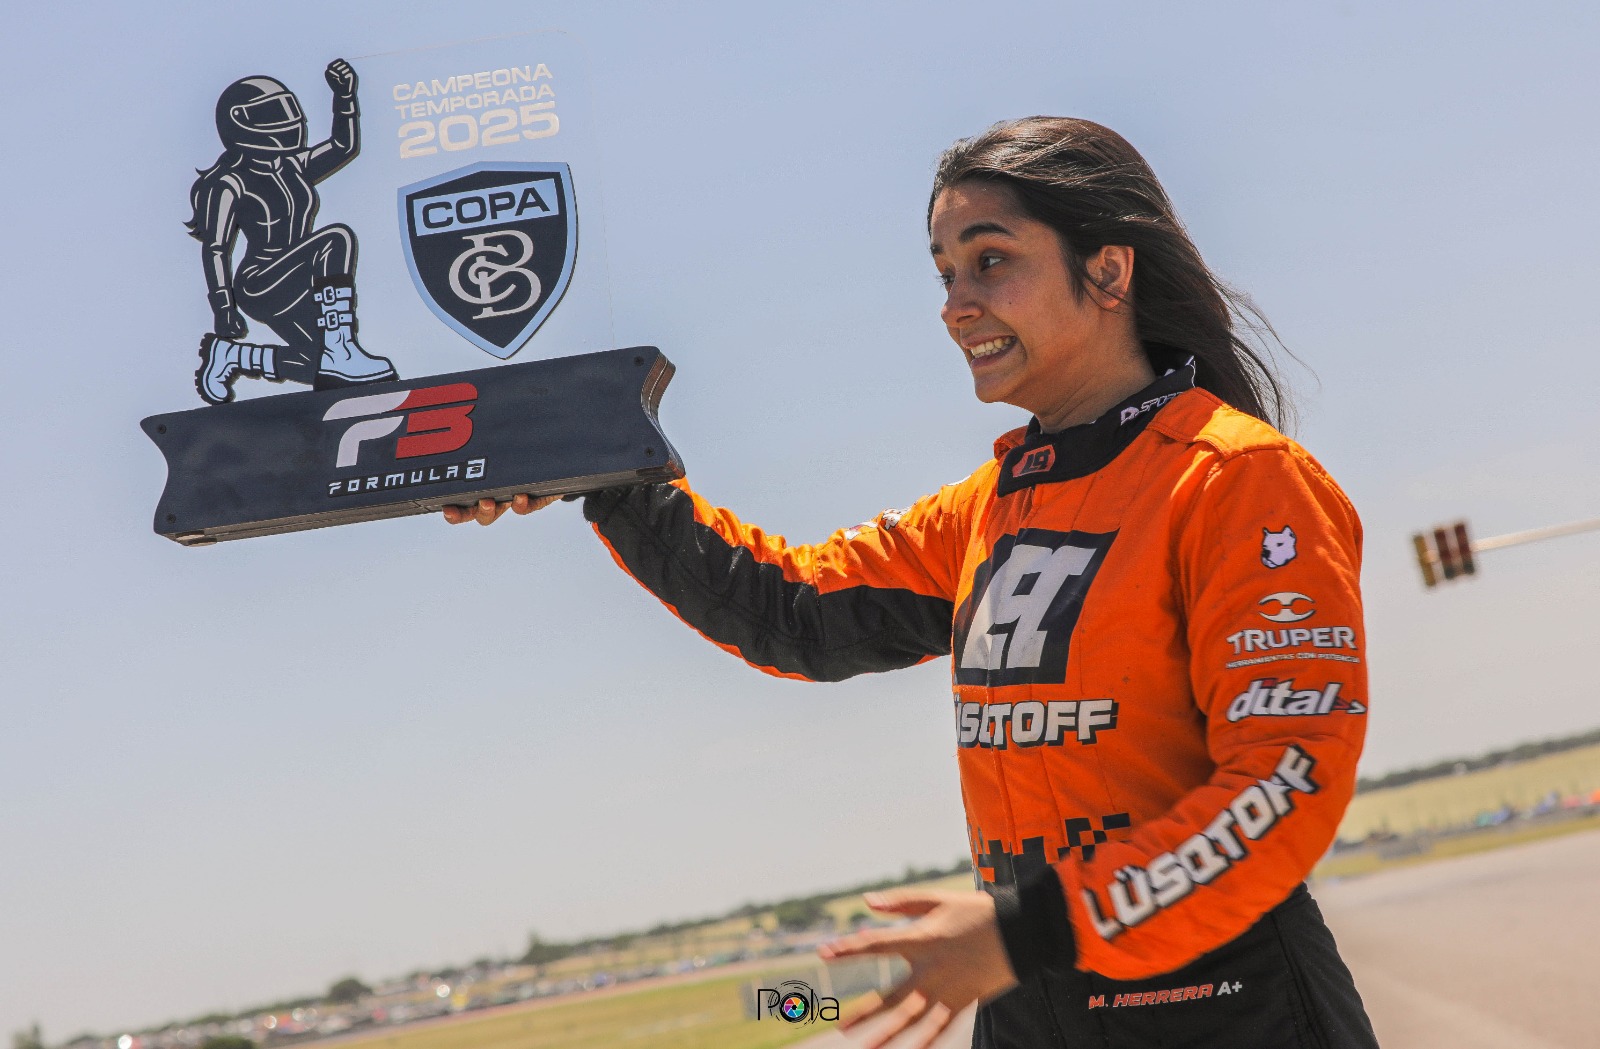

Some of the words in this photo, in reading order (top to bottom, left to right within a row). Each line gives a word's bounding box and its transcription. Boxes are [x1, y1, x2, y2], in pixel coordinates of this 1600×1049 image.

[393, 63, 553, 101] CAMPEONA
[395, 83, 556, 119] TEMPORADA
[398, 100, 560, 159] 2025
[421, 187, 551, 230] COPA
[328, 465, 459, 496] FORMULA
[1226, 626, 1358, 655] TRUPER
[1226, 677, 1344, 723] dital
[1088, 994, 1109, 1010] M.
[1112, 983, 1214, 1008] HERRERA
[1216, 981, 1243, 996] A+
